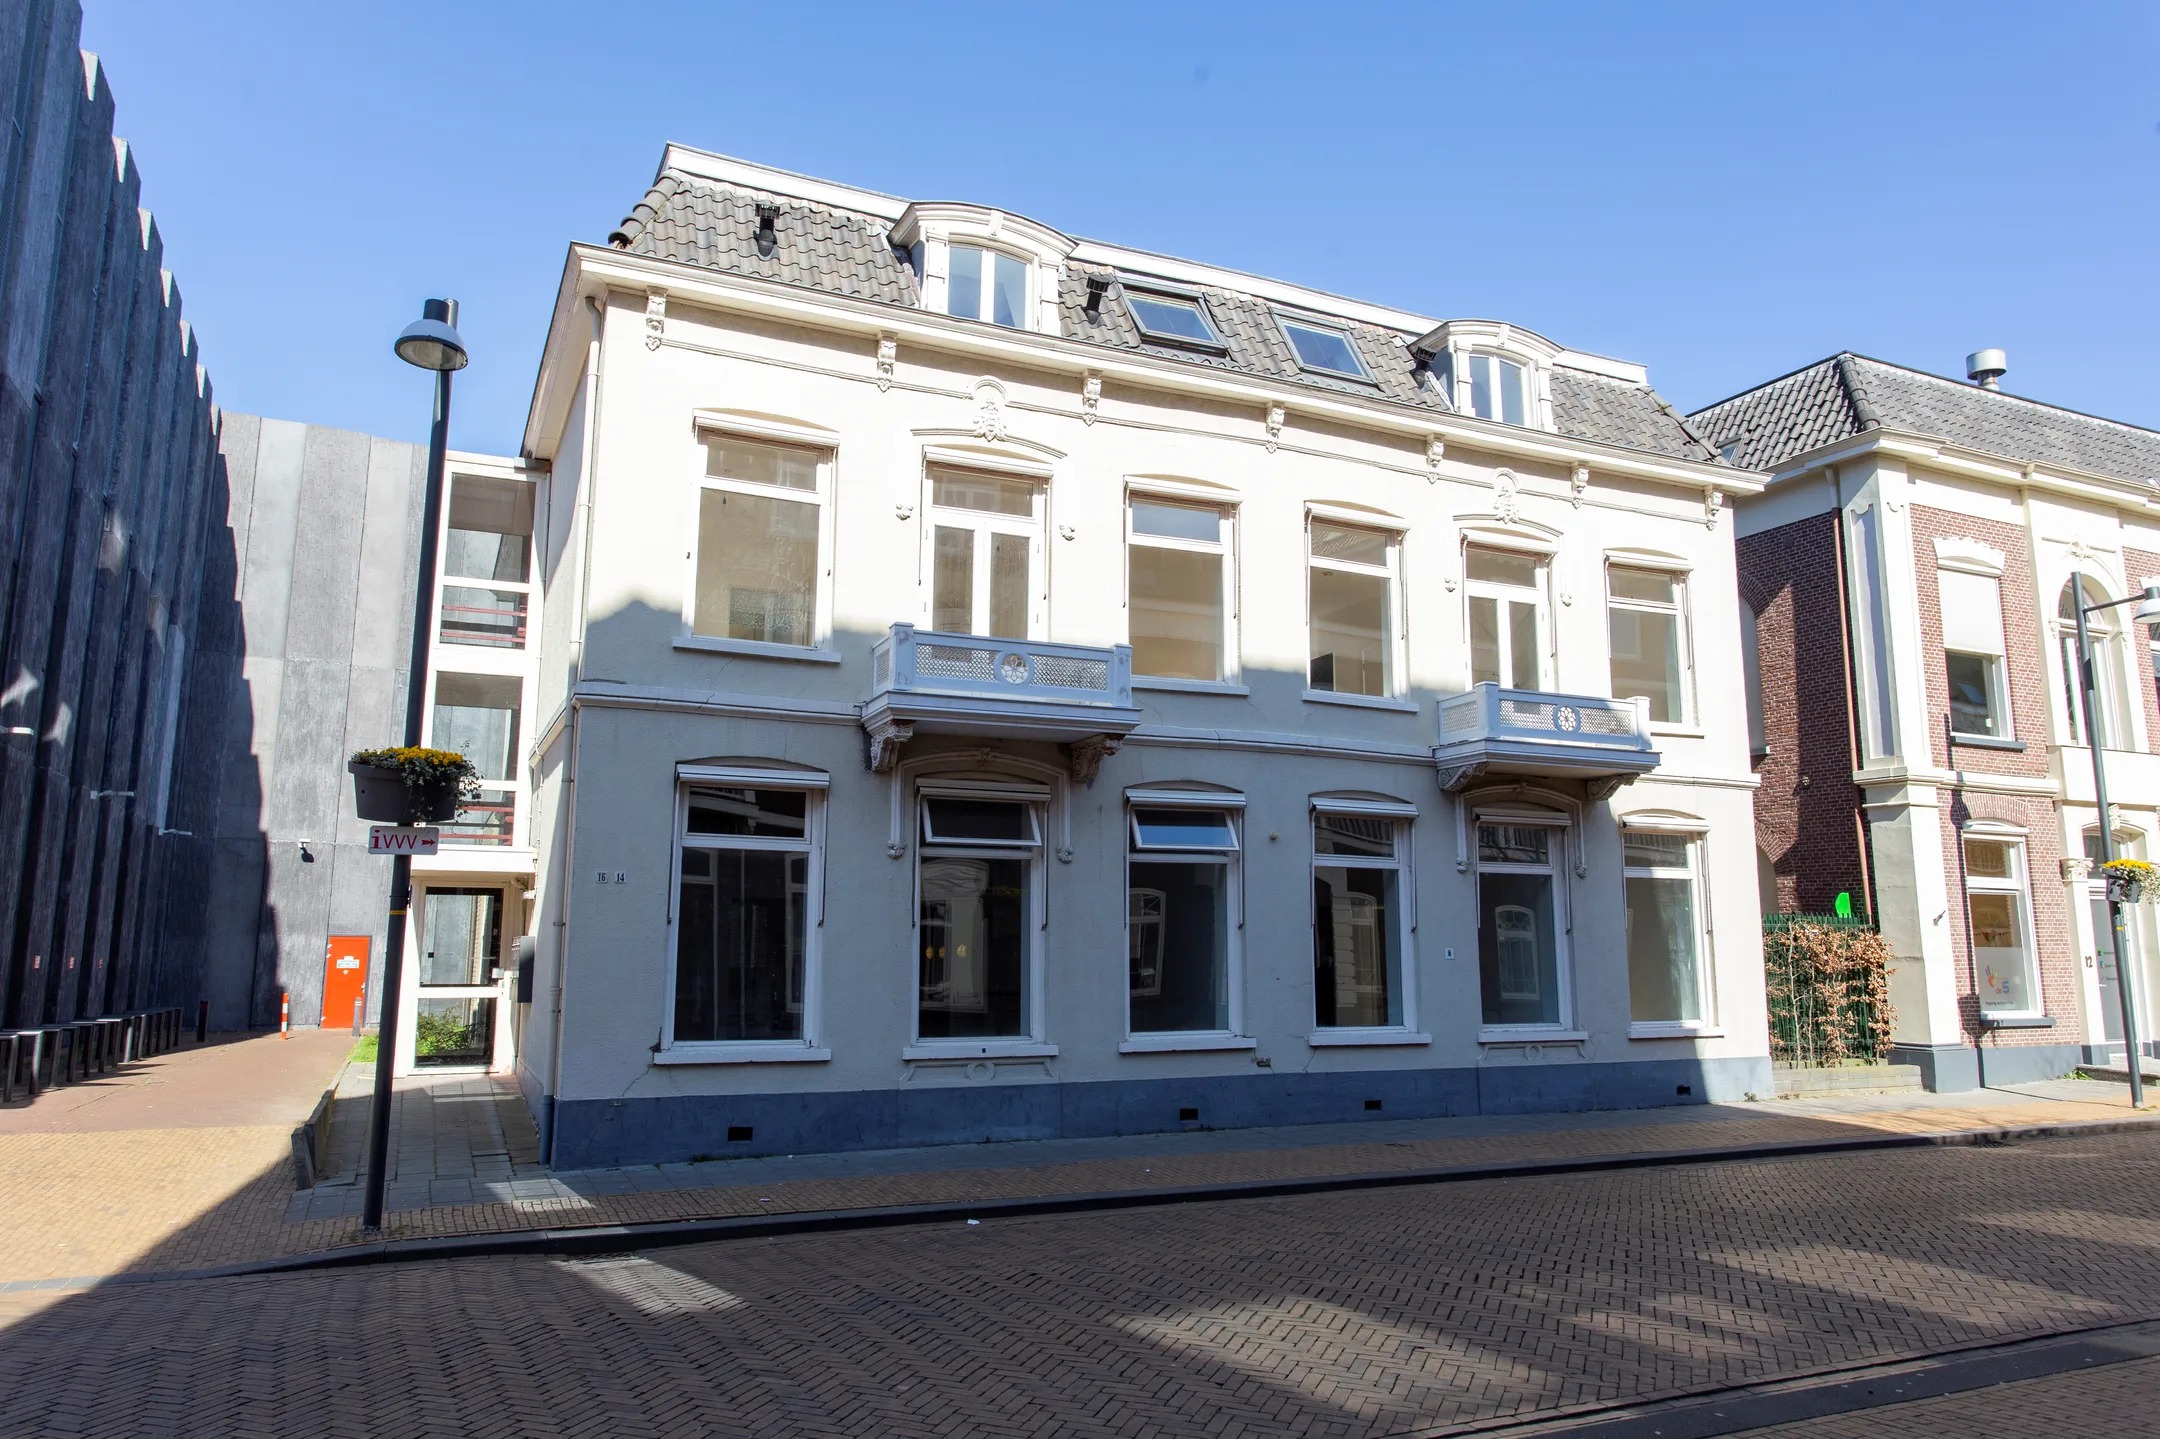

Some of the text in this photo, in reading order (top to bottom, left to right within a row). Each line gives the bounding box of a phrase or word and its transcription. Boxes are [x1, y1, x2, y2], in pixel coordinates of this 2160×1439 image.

[597, 872, 625, 882] 16 14
[2085, 955, 2093, 968] 12
